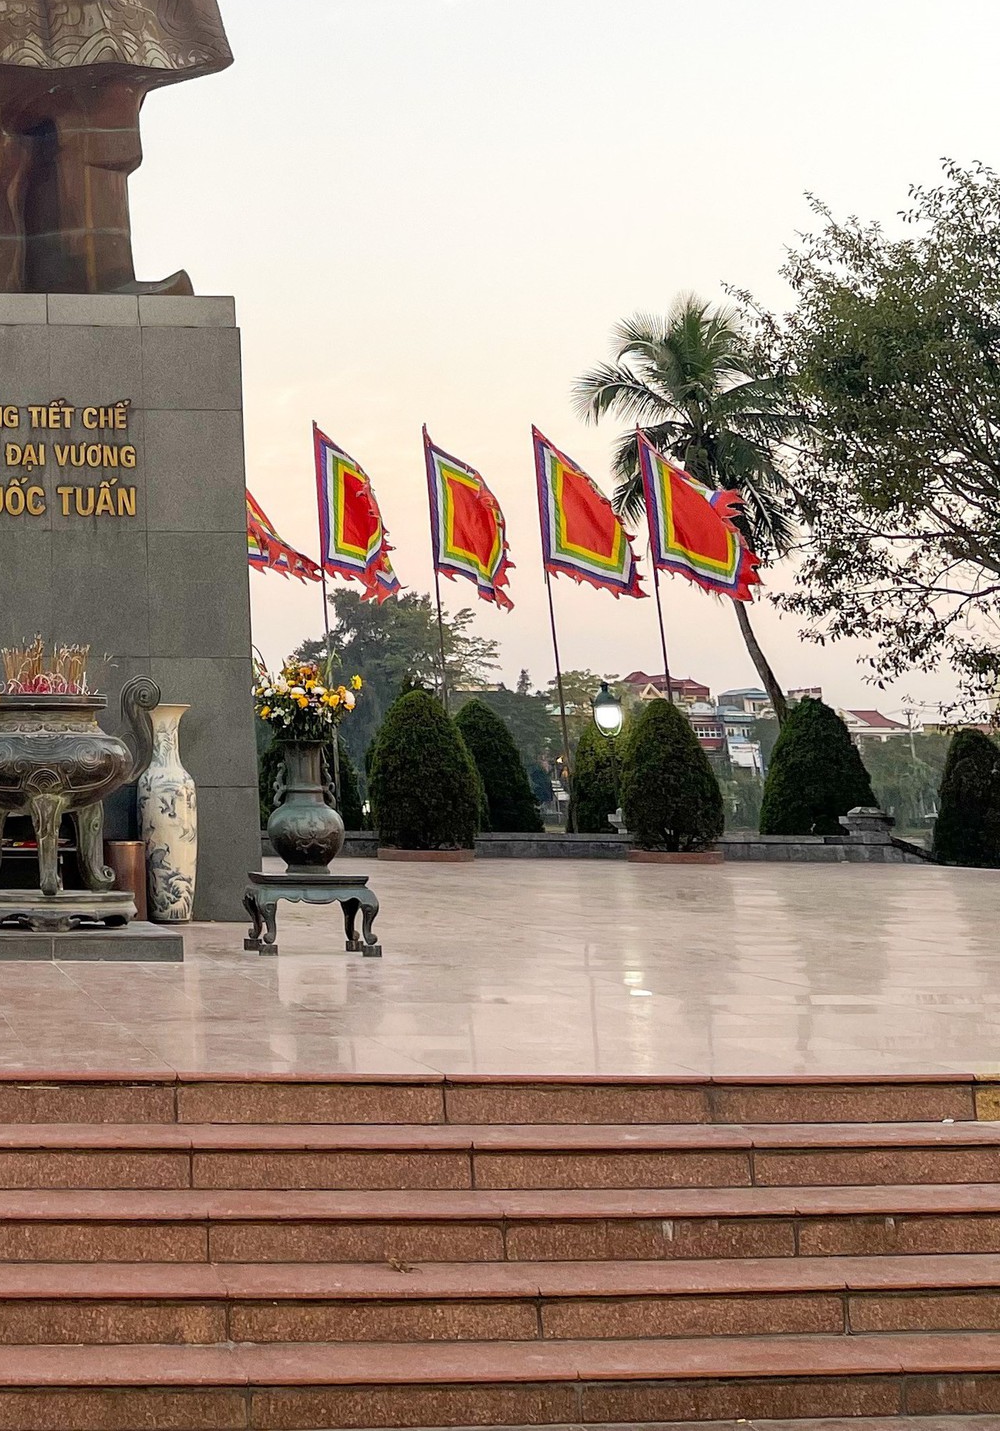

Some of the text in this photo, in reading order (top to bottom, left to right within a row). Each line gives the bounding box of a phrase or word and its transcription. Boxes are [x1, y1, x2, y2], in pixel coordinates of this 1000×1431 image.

[27, 399, 75, 429] TIẾT
[82, 399, 131, 429] CHẾ
[5, 442, 46, 471] ĐẠI
[53, 442, 136, 468] VƯƠNG
[57, 477, 136, 516] TUẤN
